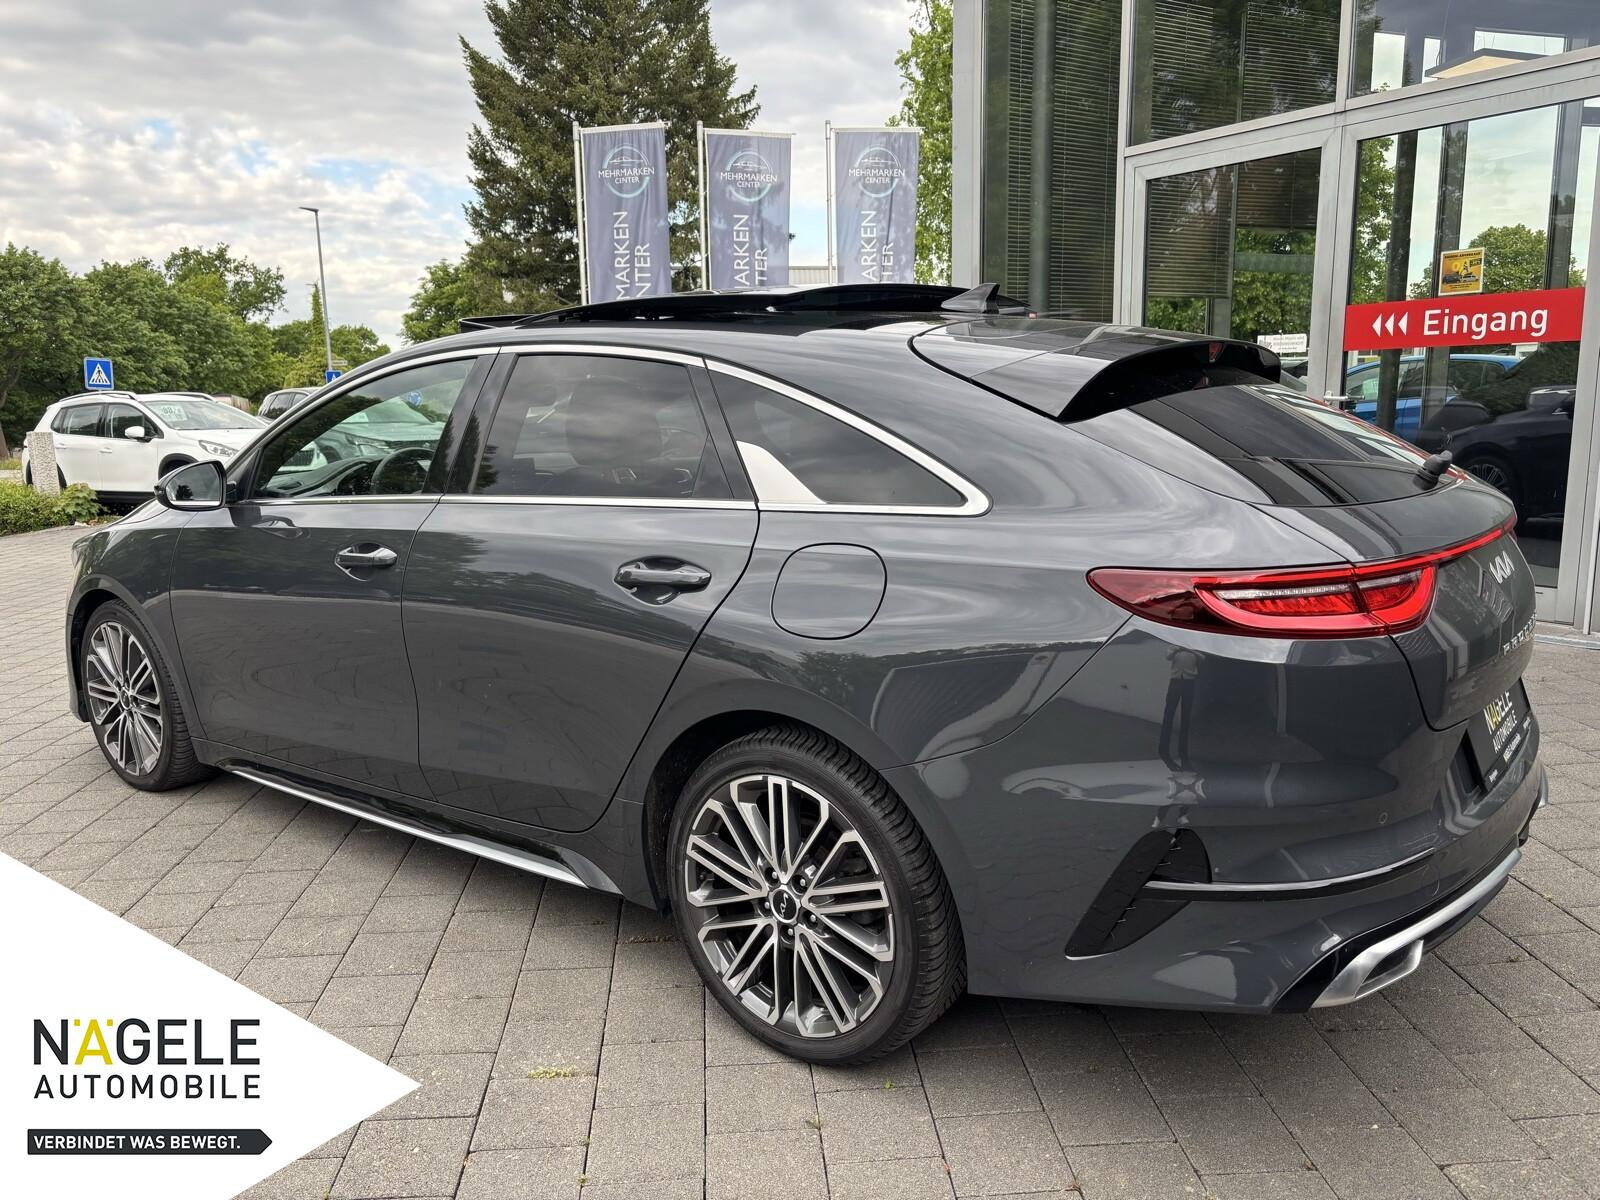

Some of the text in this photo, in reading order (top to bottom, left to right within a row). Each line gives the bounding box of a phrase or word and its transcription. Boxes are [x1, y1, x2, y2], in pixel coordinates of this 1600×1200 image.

[598, 167, 655, 178] MEHRMARKEN
[720, 172, 778, 182] MEHRMARKEN
[848, 168, 906, 177] MEHRMARKEN
[737, 180, 762, 188] CENTER
[865, 176, 890, 184] CENTER
[733, 214, 750, 288] ARKEN
[1423, 308, 1548, 339] Eingang
